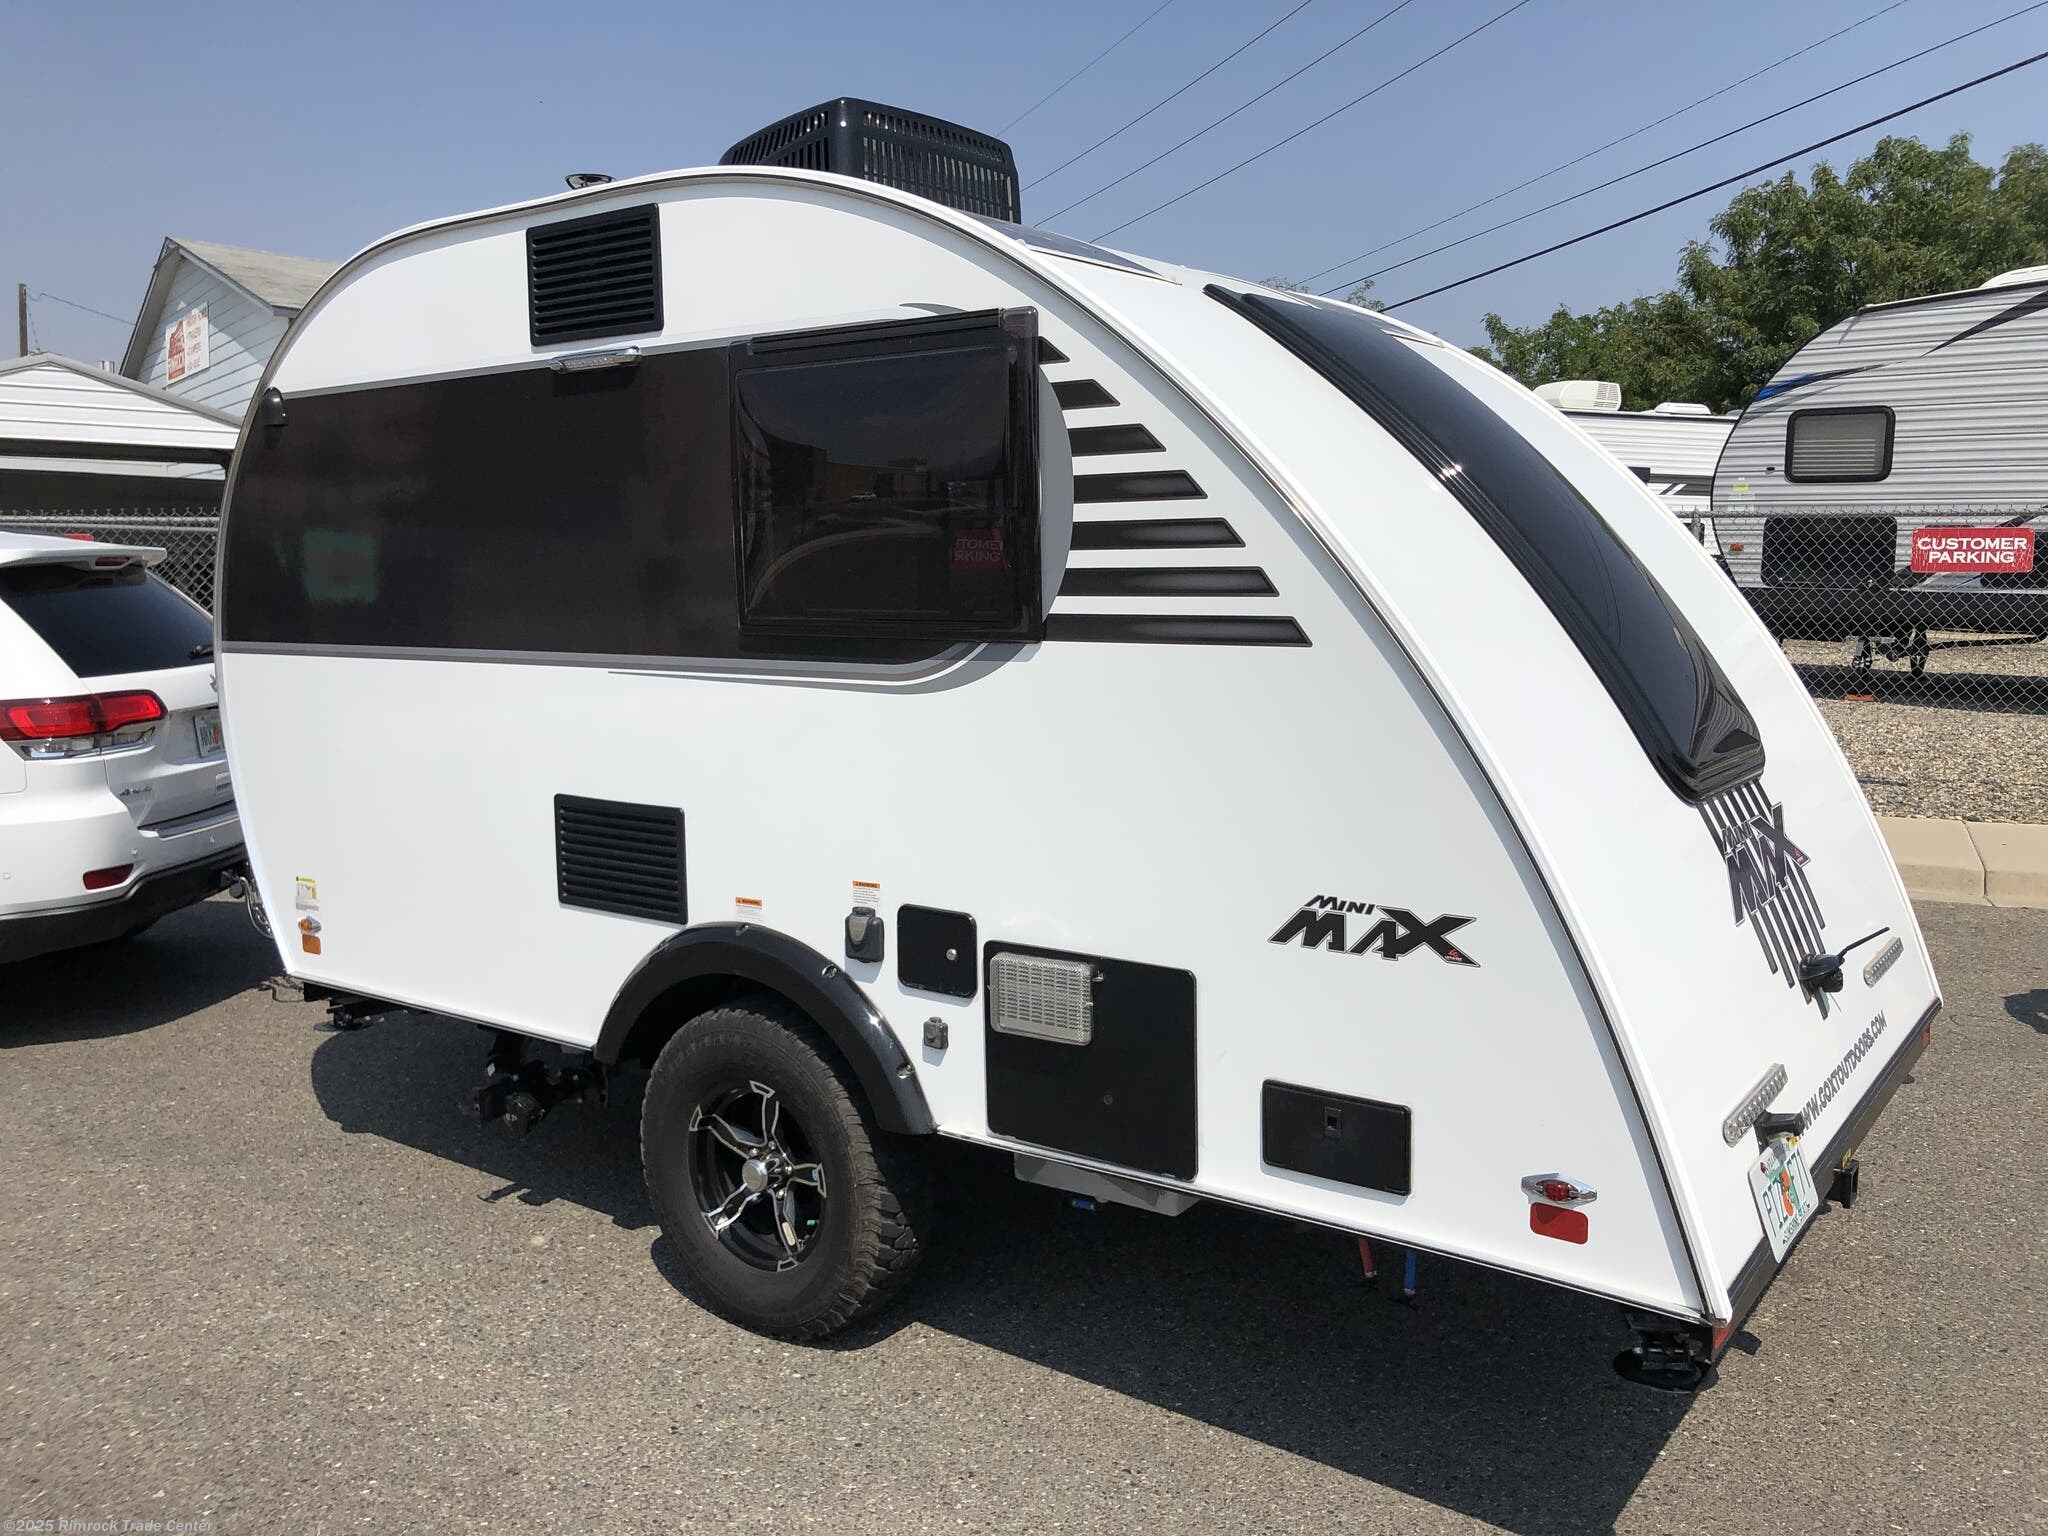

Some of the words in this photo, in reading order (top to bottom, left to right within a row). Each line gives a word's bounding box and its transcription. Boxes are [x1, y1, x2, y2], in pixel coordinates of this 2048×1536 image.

[1917, 537, 2028, 550] CUSTOMER
[1928, 551, 2015, 564] PARKING
[1724, 801, 1812, 927] MAX
[1303, 894, 1376, 915] MINI
[1267, 905, 1481, 968] MAX
[1800, 1009, 1888, 1140] WW.GOXTOUTDOORS.COM
